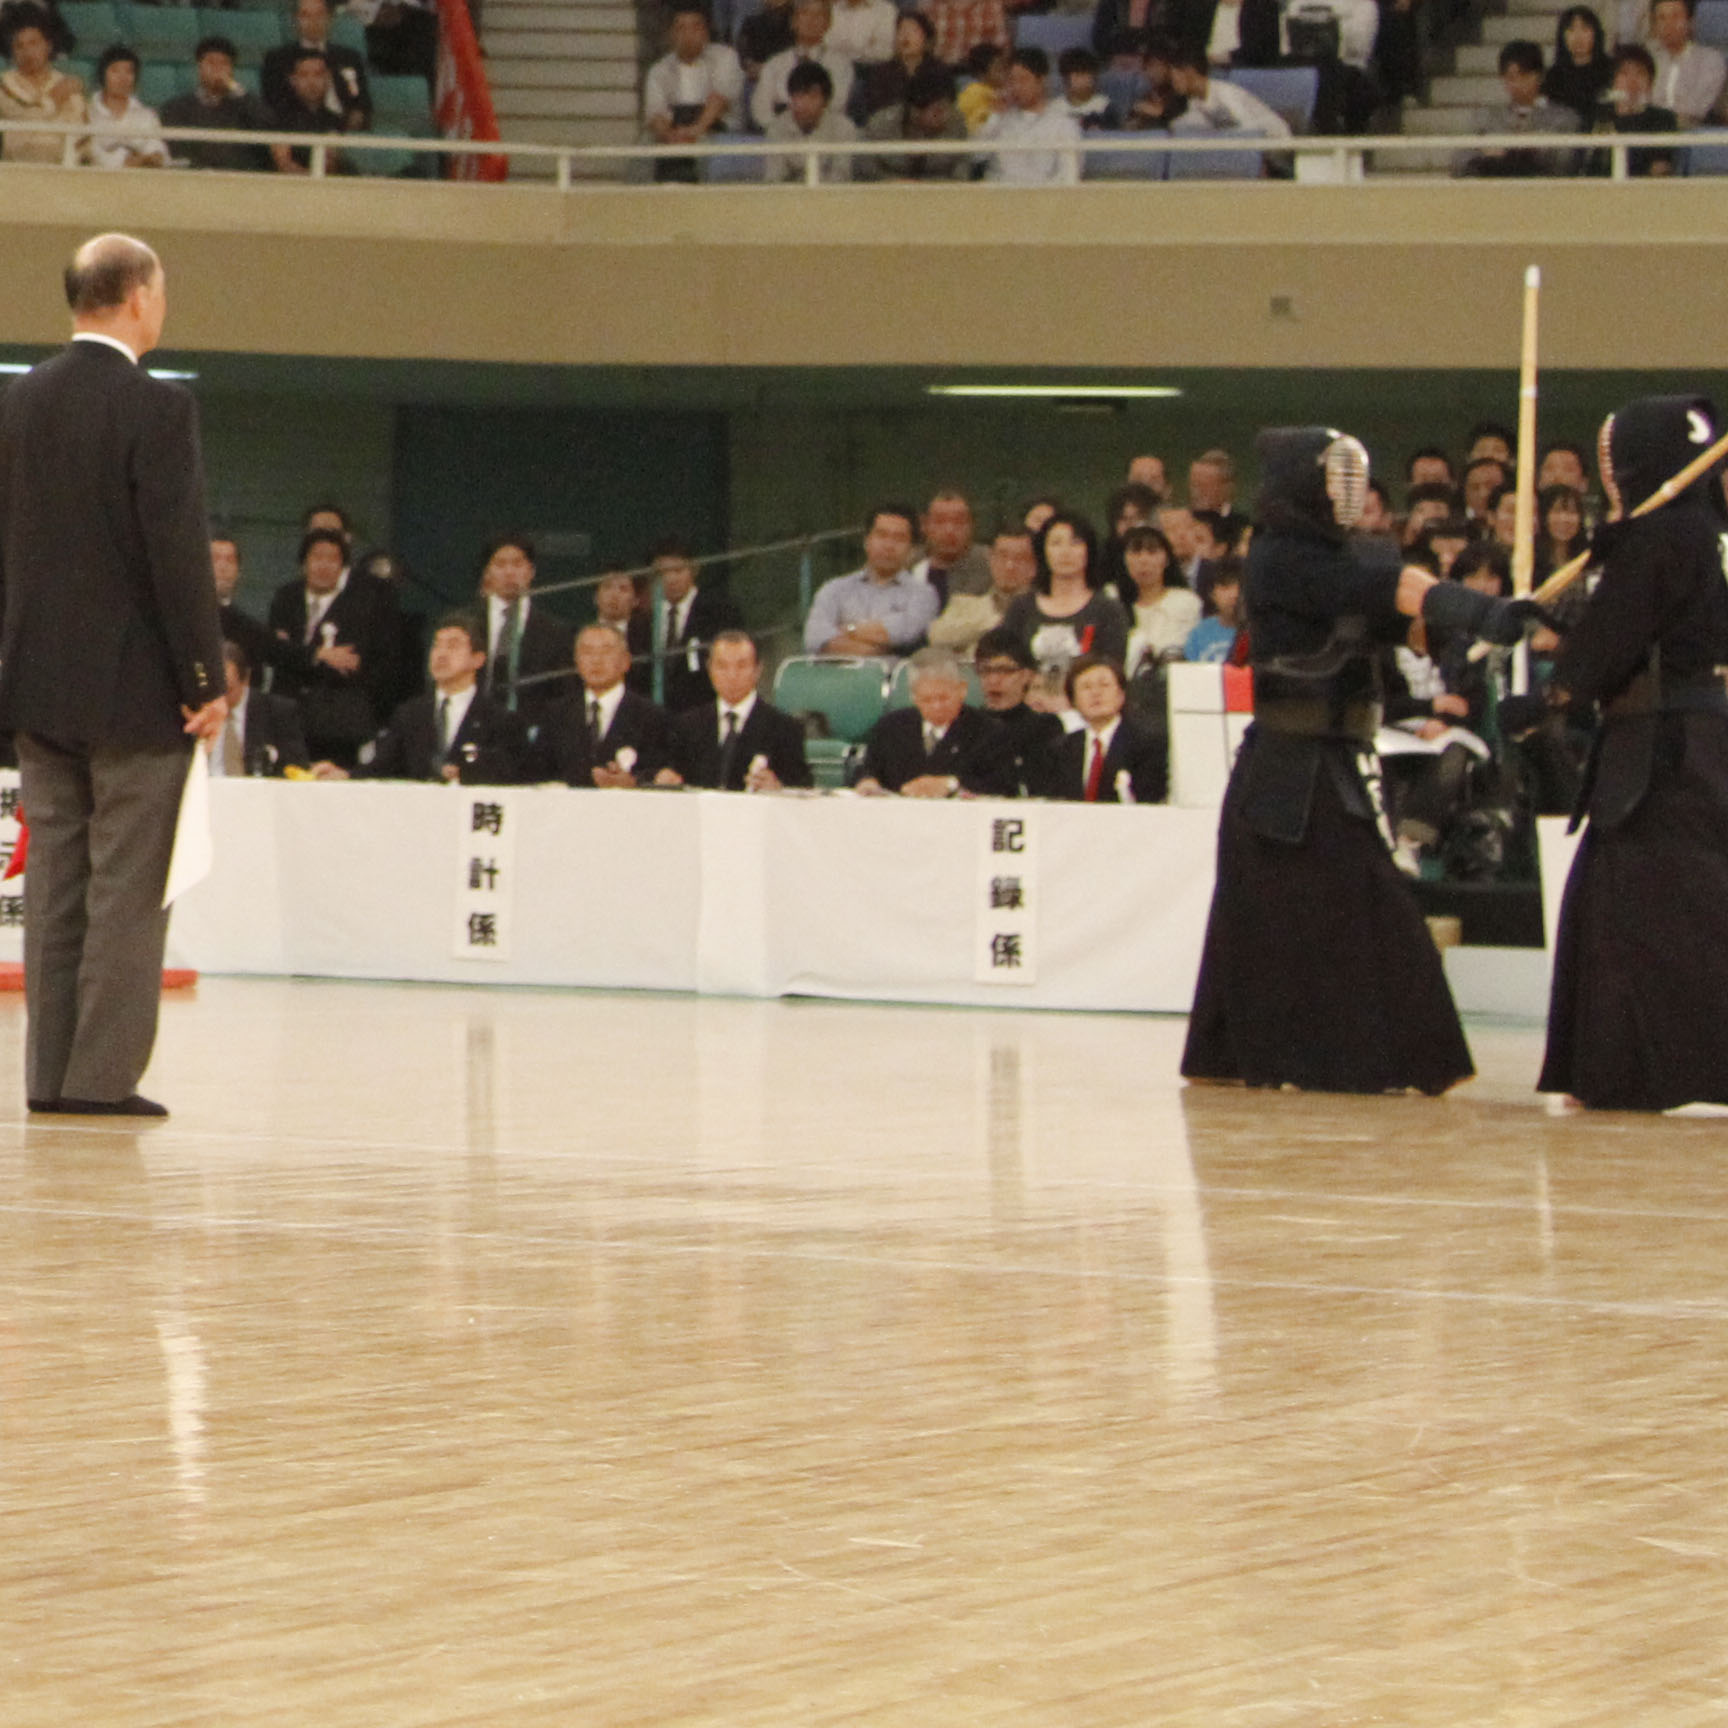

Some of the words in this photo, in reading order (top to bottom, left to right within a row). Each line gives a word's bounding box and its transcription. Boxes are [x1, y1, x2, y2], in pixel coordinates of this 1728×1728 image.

[468, 801, 504, 946] 時計係
[990, 819, 1025, 968] 記録係
